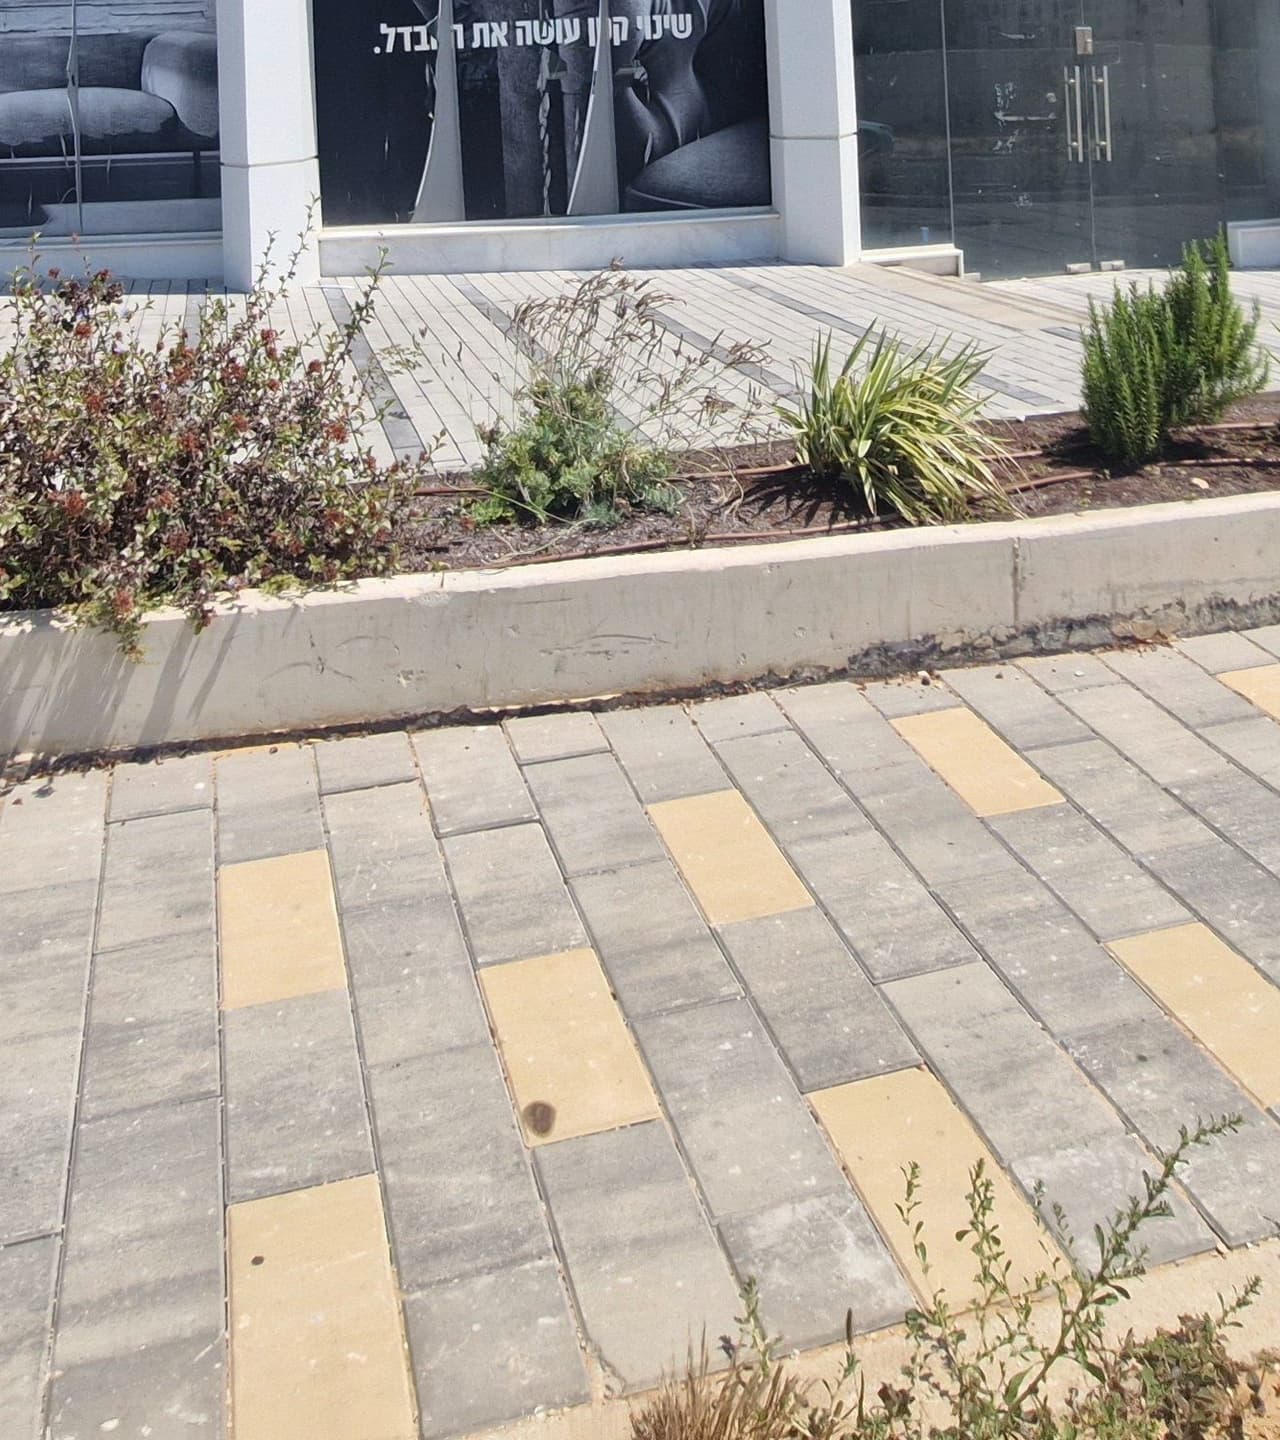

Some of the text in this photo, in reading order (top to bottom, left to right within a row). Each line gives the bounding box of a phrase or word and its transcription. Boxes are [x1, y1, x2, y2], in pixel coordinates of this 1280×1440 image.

[471, 21, 508, 49] את
[515, 17, 580, 46] עושה
[636, 13, 692, 40] שינוי
